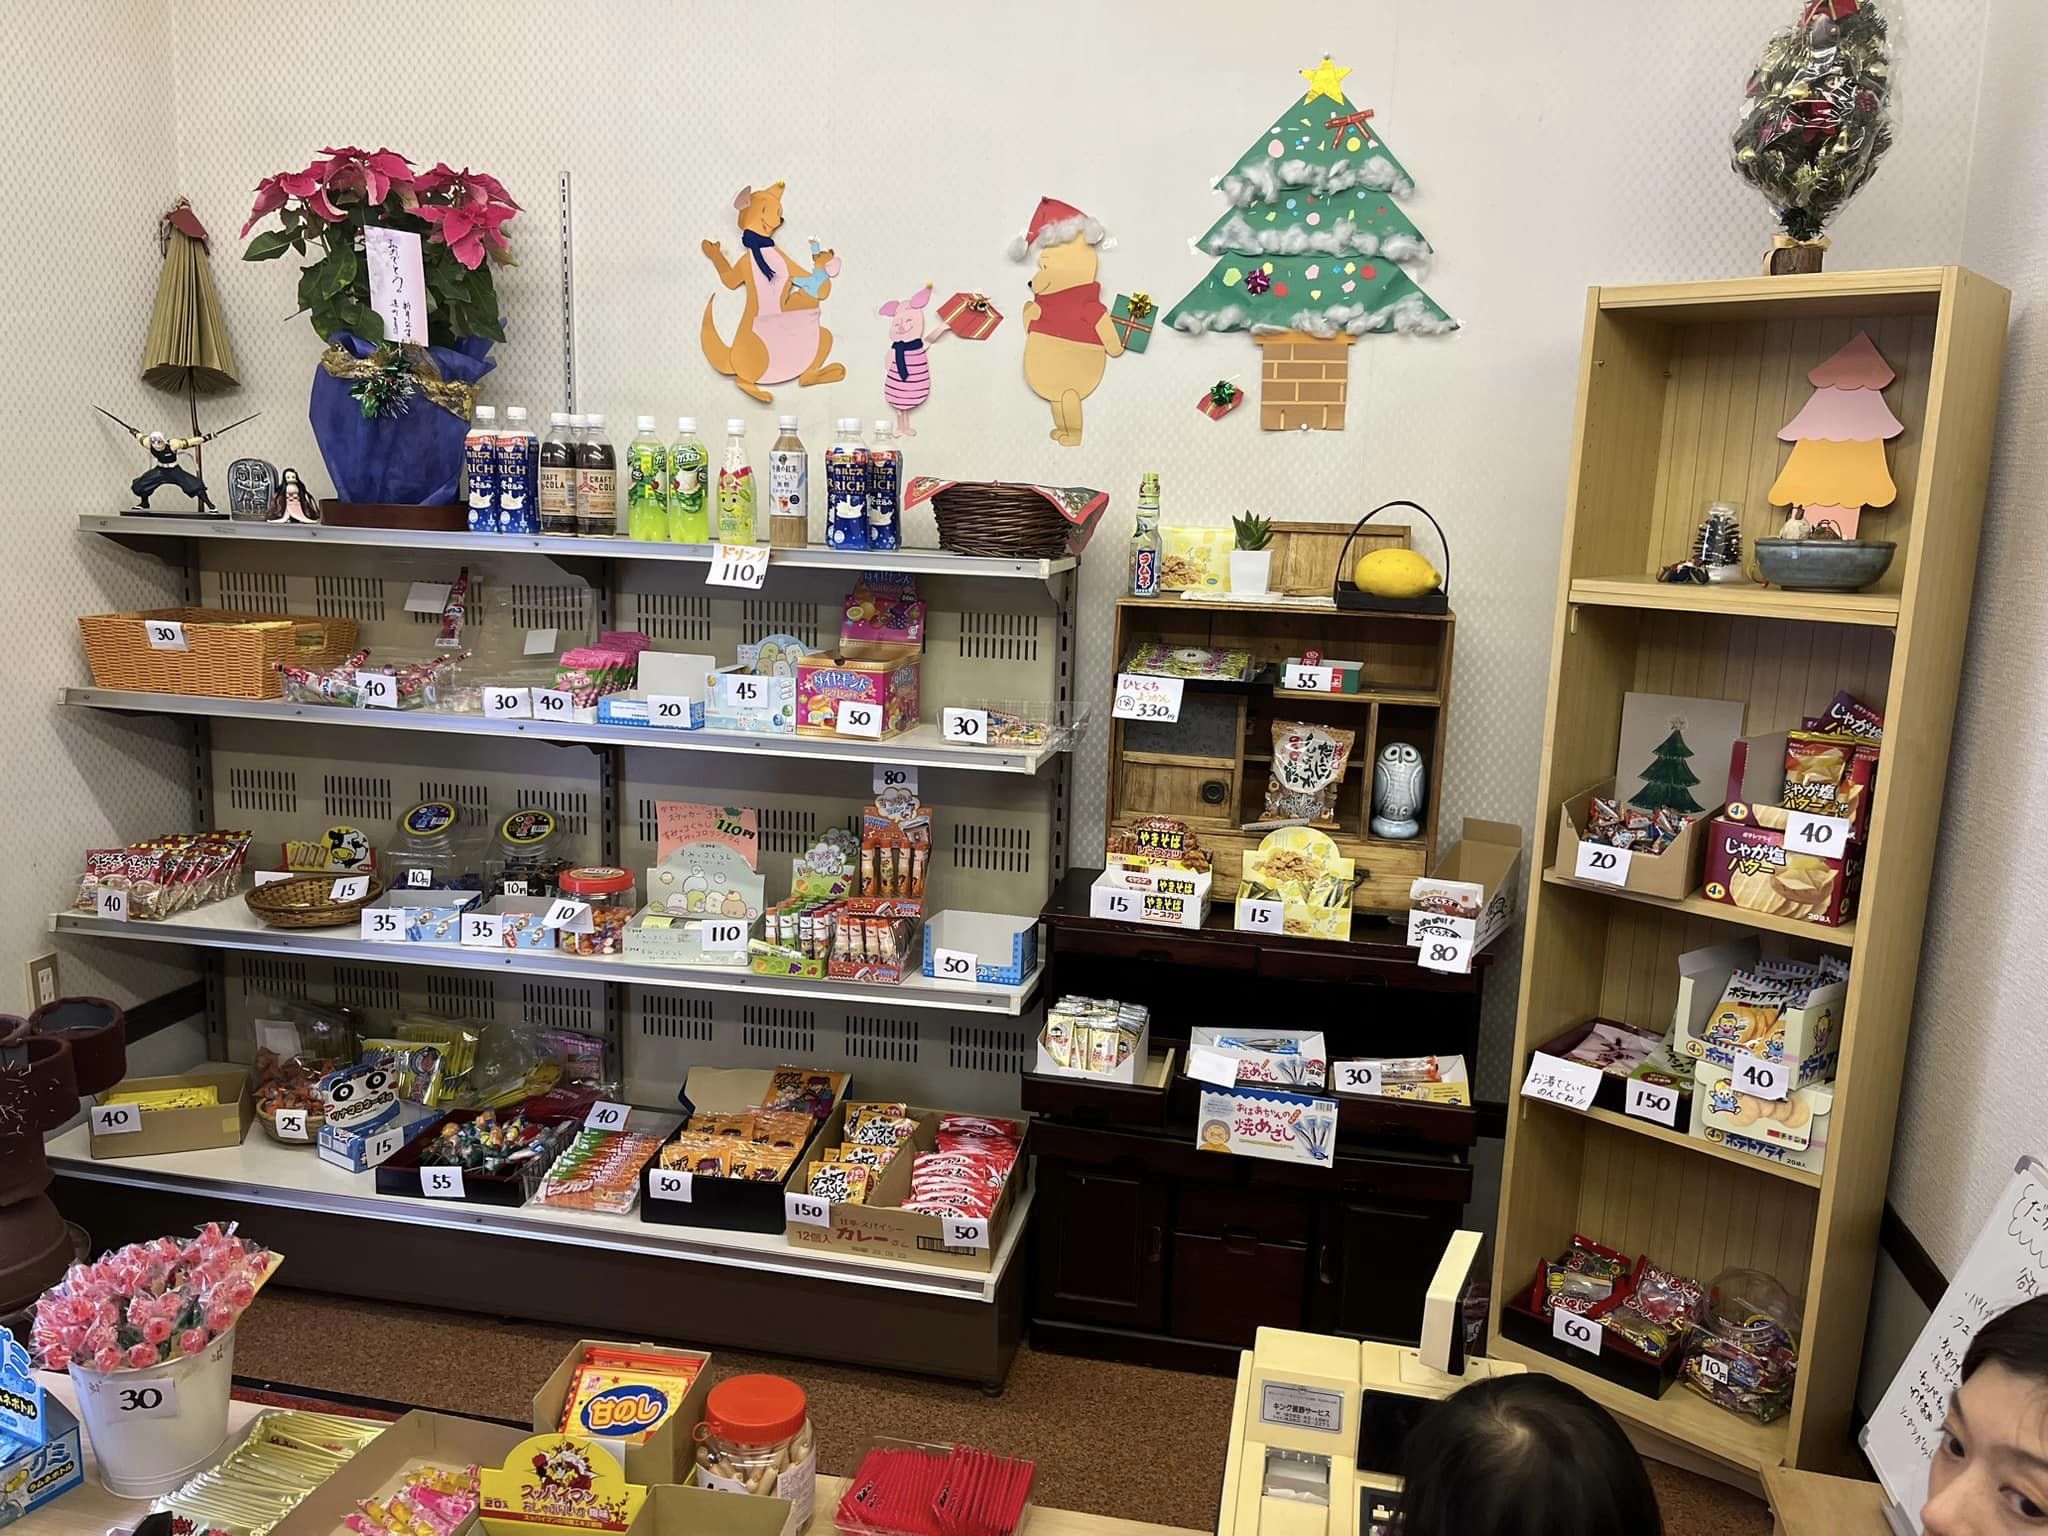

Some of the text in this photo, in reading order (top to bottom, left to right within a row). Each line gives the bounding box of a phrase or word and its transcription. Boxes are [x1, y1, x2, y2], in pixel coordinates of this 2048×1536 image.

[589, 474, 611, 483] CRAFT
[835, 481, 865, 491] RICH
[873, 481, 895, 490] ICH
[721, 546, 766, 561] ドリンク
[1138, 552, 1151, 588] ラムネ
[154, 626, 175, 641] 30
[364, 680, 386, 697] 40
[813, 671, 869, 690] ダイヤモンド
[1123, 679, 1160, 692] ひとくち
[1296, 673, 1320, 688] 55
[736, 682, 757, 700] 45
[494, 695, 518, 710] 30
[540, 695, 564, 711] 40
[659, 703, 682, 717] 20
[849, 710, 871, 726] 50
[952, 716, 979, 735] 30
[884, 770, 906, 784] 80
[717, 819, 755, 840] 110円
[1800, 822, 1832, 843] 40
[1140, 831, 1182, 849] やきそば
[1725, 837, 1786, 865] じゃが塩
[1148, 858, 1168, 867] ソース
[1589, 851, 1617, 870] 20
[1728, 858, 1775, 876] バター
[341, 883, 358, 897] 15
[1159, 880, 1194, 895] やきそば
[104, 896, 121, 912] 40
[1110, 896, 1129, 912] 15
[1145, 895, 1183, 911] やきそば
[556, 907, 575, 919] 10
[1145, 909, 1182, 920] ソースカツ
[1251, 907, 1272, 924] 15
[373, 915, 396, 931] 35
[472, 921, 493, 937] 35
[712, 926, 740, 942] 110
[1430, 943, 1458, 961] 80
[944, 958, 969, 974] 50
[1345, 1068, 1372, 1086] 30
[1531, 1072, 1587, 1096] お湯でといて
[1743, 1066, 1774, 1088] 40
[1636, 1090, 1671, 1111] 150
[101, 1112, 128, 1127] 40
[282, 1117, 301, 1132] 25
[1234, 1118, 1296, 1142] 焼めざし
[375, 1138, 392, 1156] 15
[1726, 1133, 1786, 1162] ポテトフライ
[433, 1174, 452, 1190] 55
[660, 1176, 681, 1192] 50
[795, 1202, 822, 1217] 150
[796, 1231, 832, 1245] 12個入
[836, 1227, 889, 1244] カレー
[955, 1226, 979, 1241] 50
[1565, 1320, 1590, 1341] 60
[119, 1388, 163, 1411] 30
[588, 1395, 661, 1428] 甘のし
[30, 1443, 71, 1479] グミ
[28, 1463, 74, 1493] ラムネボトル
[521, 1484, 599, 1506] スッパイマン
